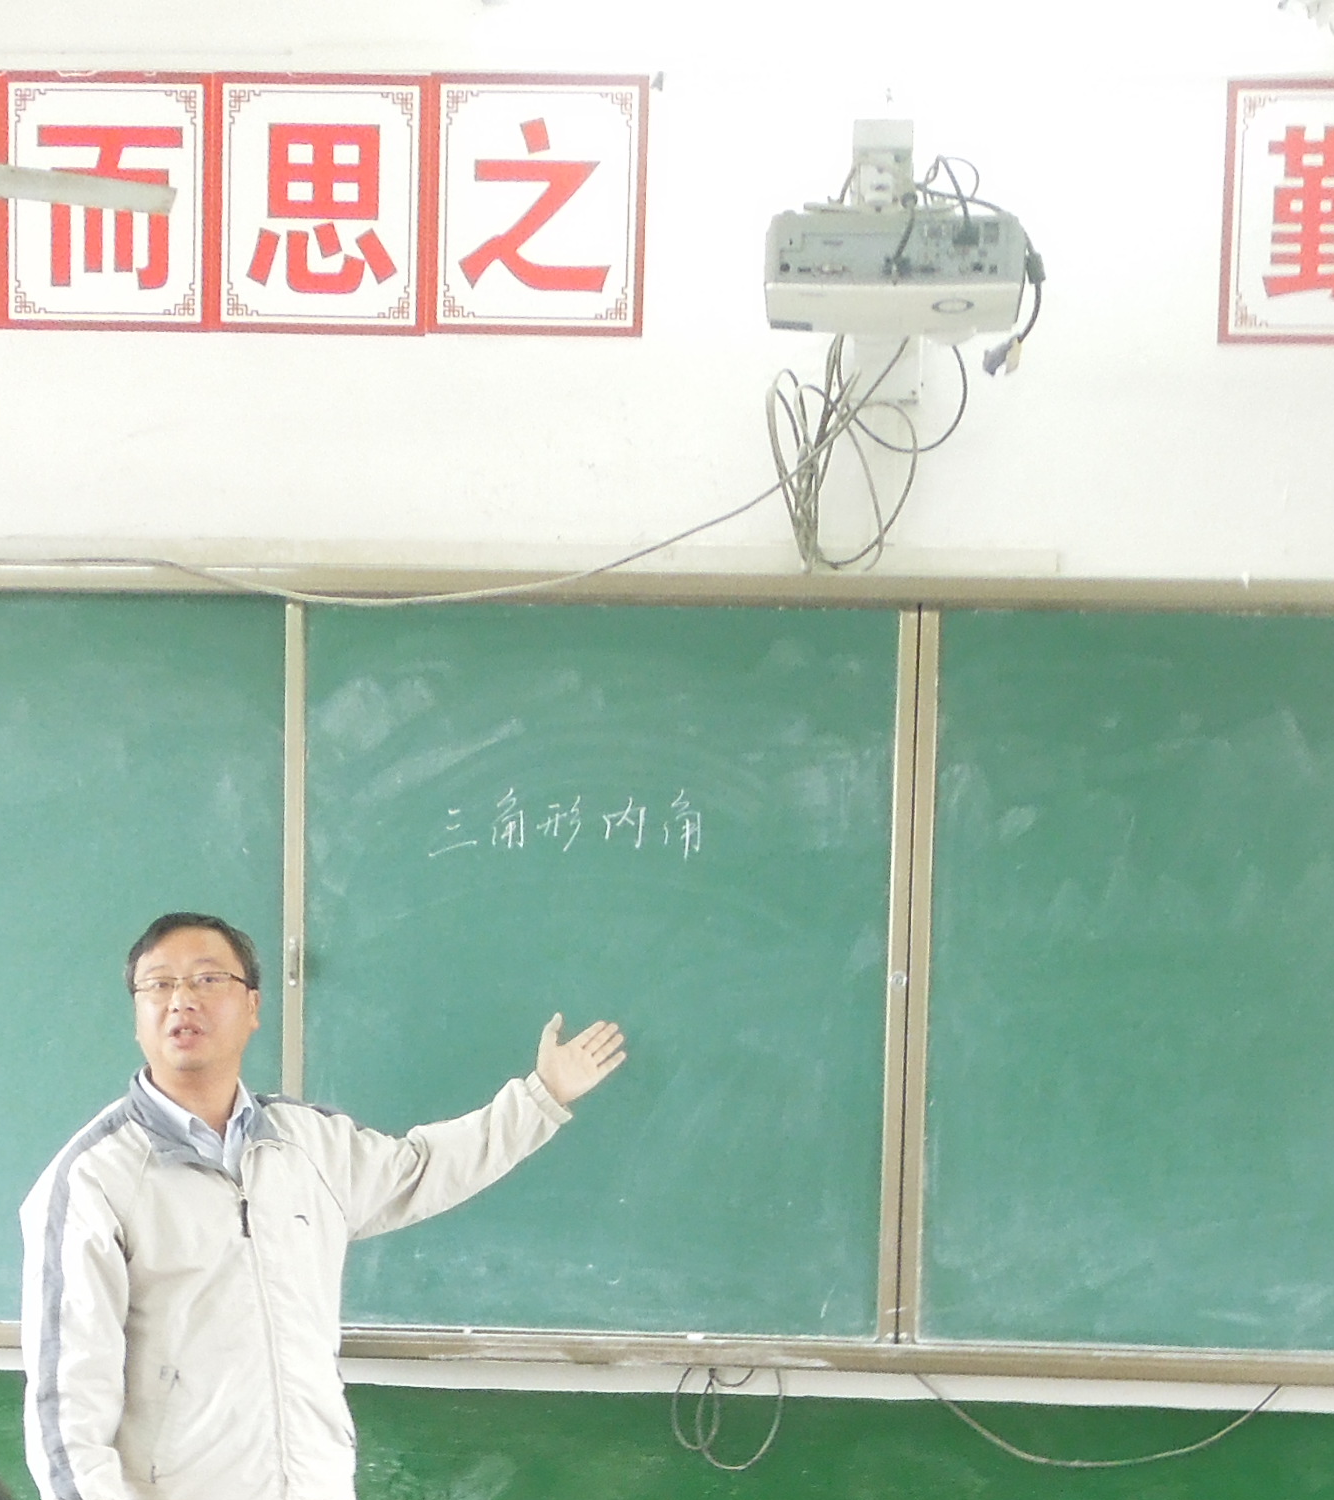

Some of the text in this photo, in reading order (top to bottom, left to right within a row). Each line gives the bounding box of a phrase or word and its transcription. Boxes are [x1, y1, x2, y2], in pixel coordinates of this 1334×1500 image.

[428, 787, 702, 862] 三角形内角
